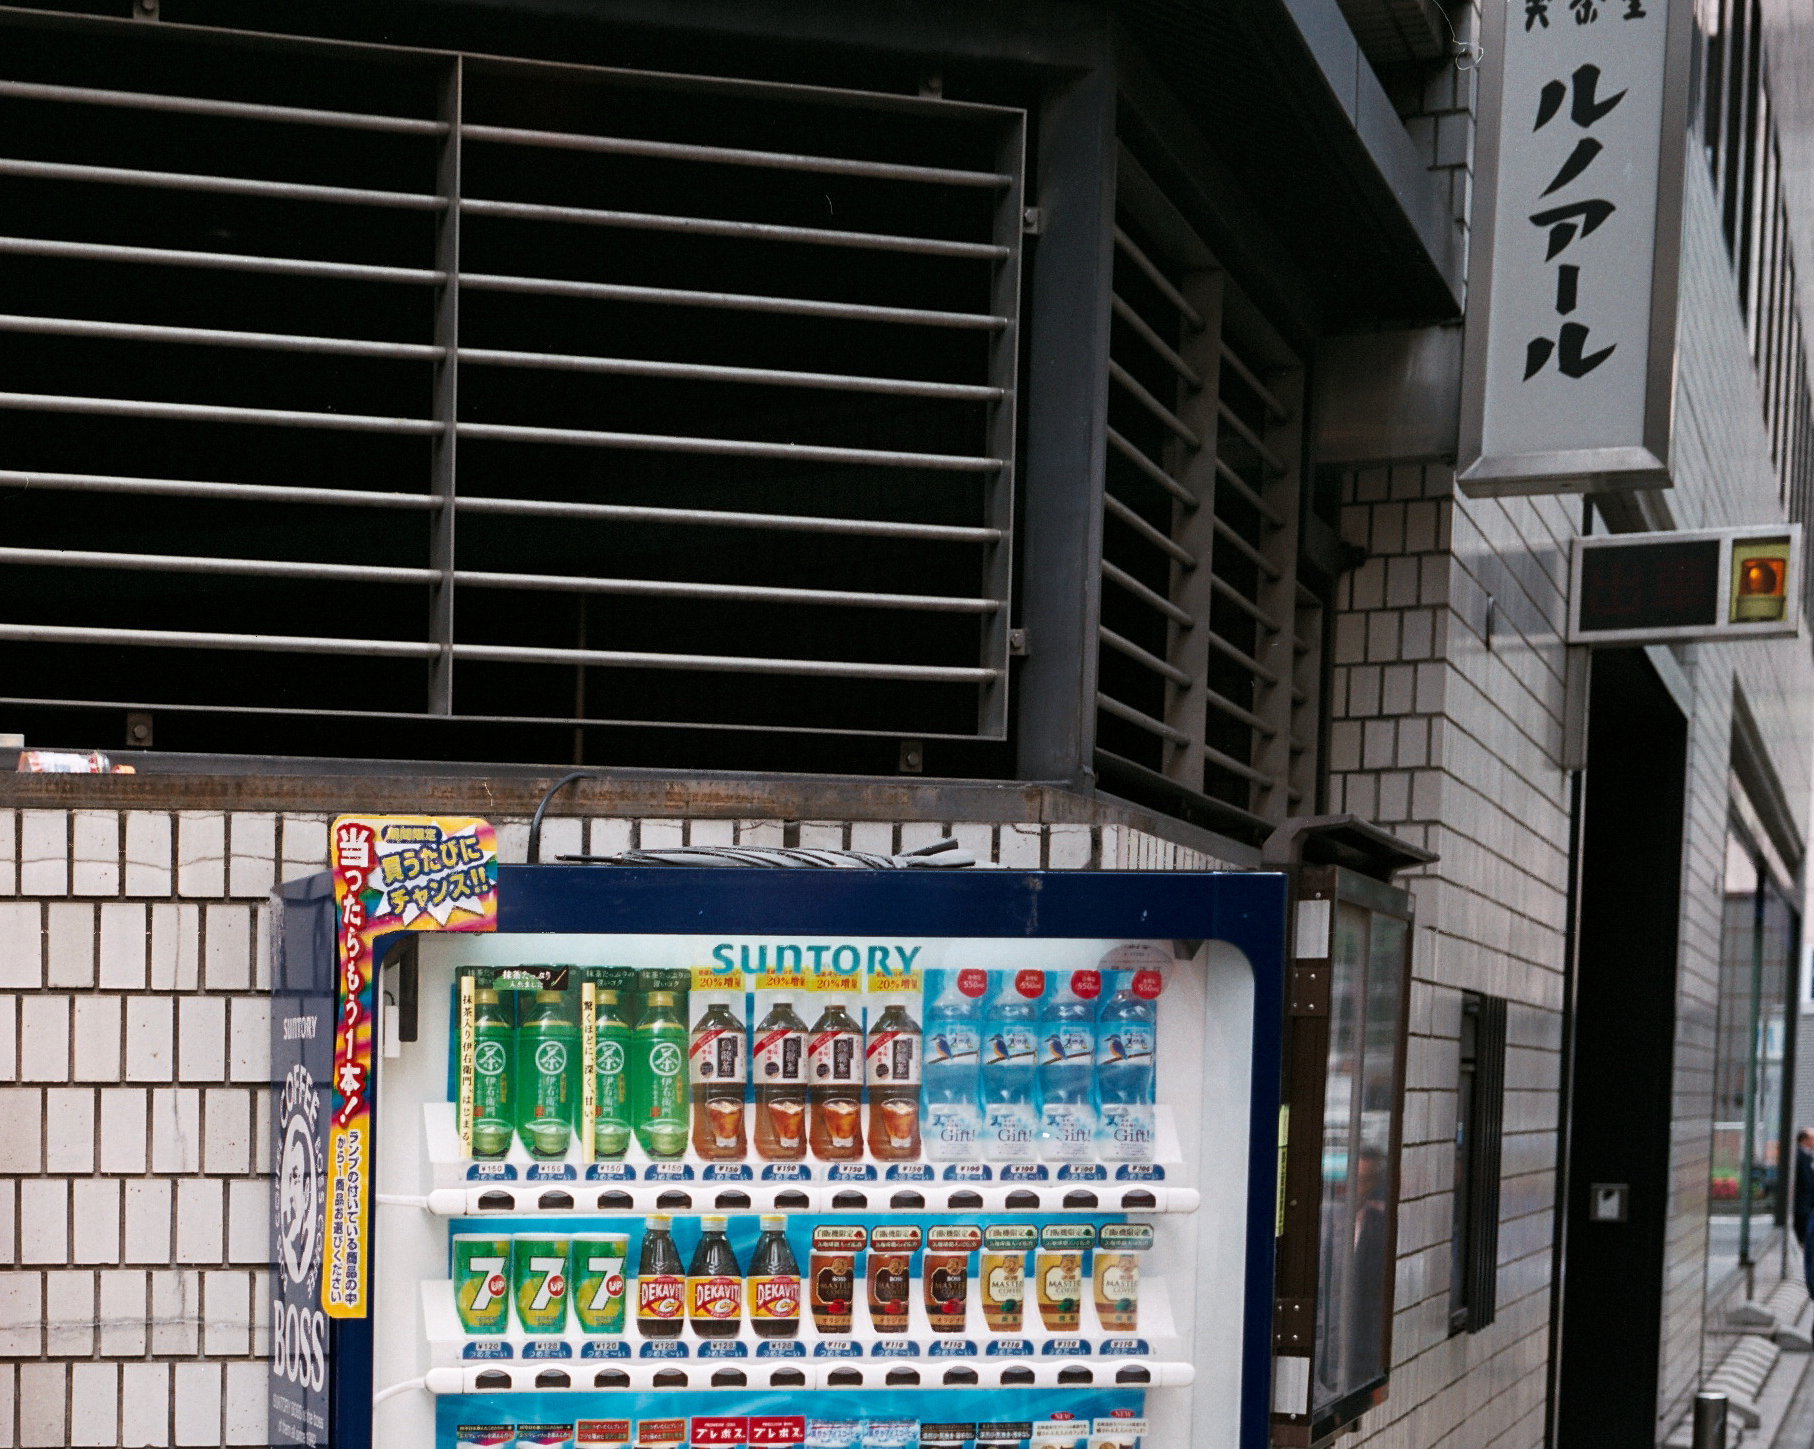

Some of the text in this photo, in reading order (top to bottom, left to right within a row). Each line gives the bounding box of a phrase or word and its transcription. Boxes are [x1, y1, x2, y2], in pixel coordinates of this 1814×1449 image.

[1522, 62, 1629, 384] ルノアール
[388, 828, 437, 841] 期間限定
[382, 837, 481, 883] 買うたびに
[388, 866, 488, 913] チャンス!!
[712, 943, 922, 975] SUNTORY
[339, 827, 370, 1124] 当ったらもう1本!
[478, 1044, 504, 1070] 茶
[538, 1044, 564, 1070] 茶
[596, 1044, 622, 1070] 茶
[652, 1045, 679, 1071] 茶
[940, 1128, 976, 1142] Gift!
[997, 1128, 1033, 1142] Gift!
[1114, 1128, 1150, 1142] Gift!
[345, 1131, 359, 1305] ランプの付いている商品の中
[469, 1256, 507, 1310] 7 UP
[528, 1256, 566, 1310] 7 UP
[587, 1256, 625, 1310] 7 UP
[658, 1298, 675, 1312] C
[714, 1298, 730, 1312] C
[774, 1298, 791, 1312] C
[273, 1299, 325, 1393] BOSS
